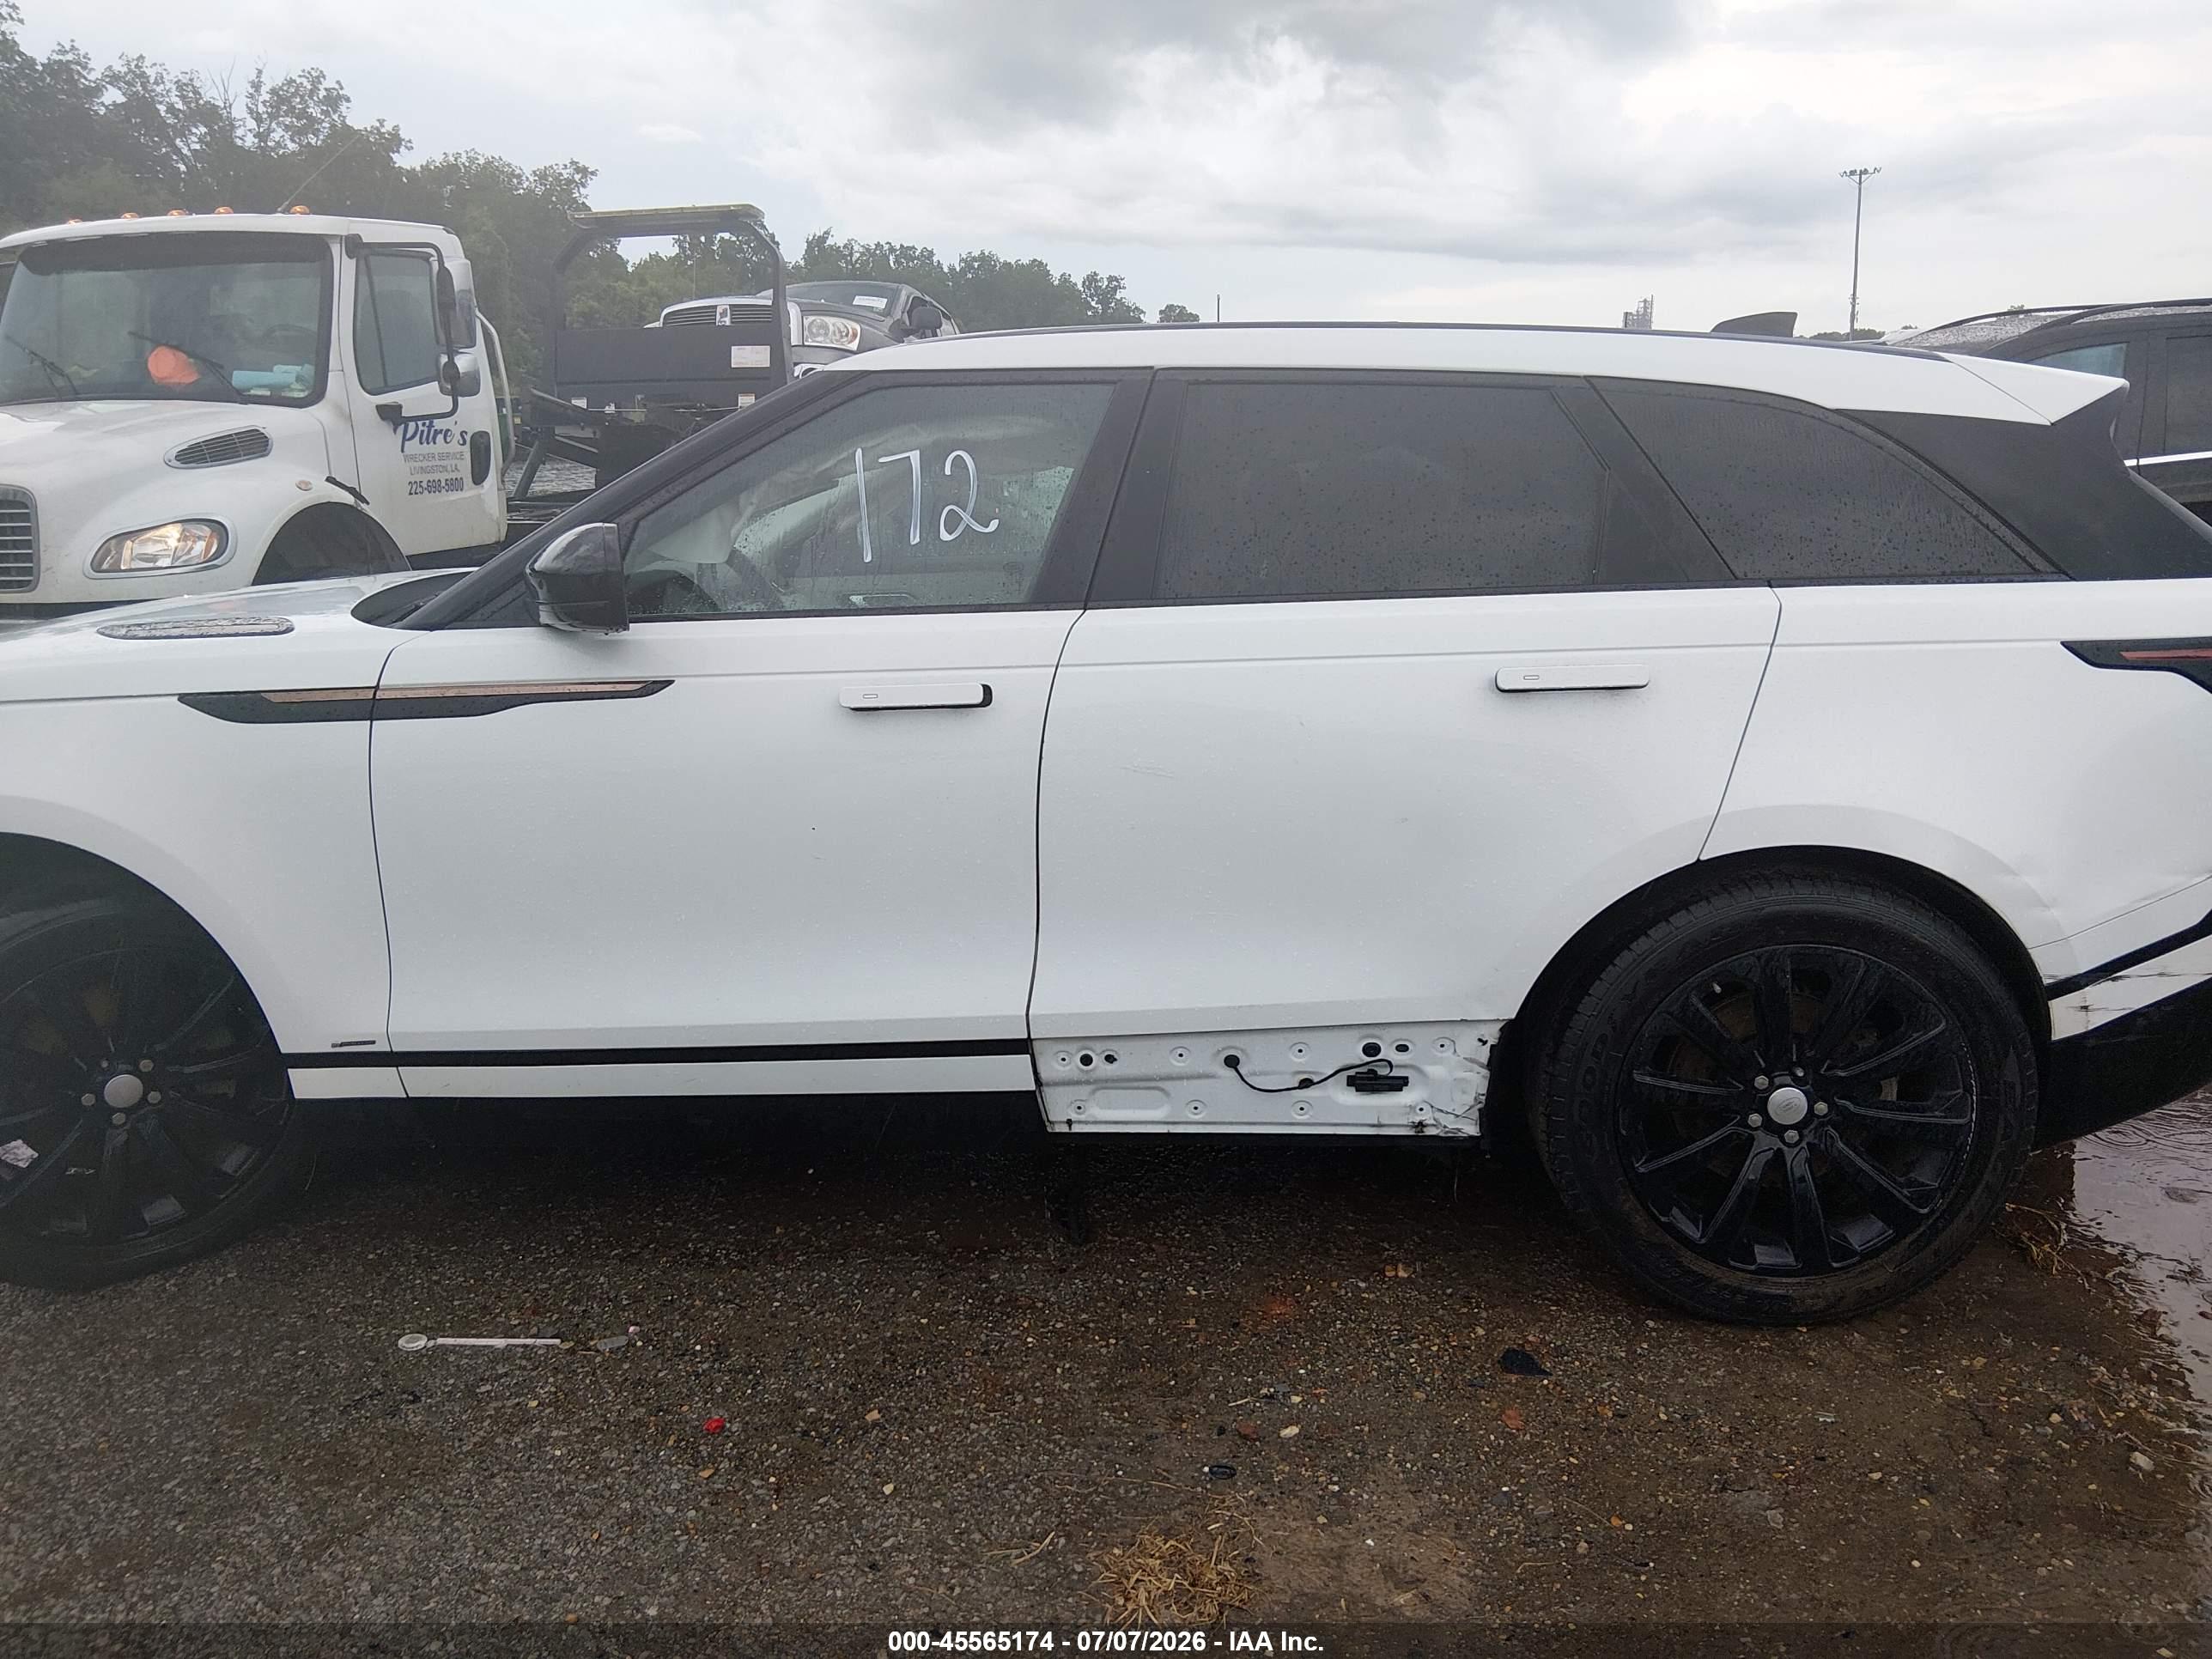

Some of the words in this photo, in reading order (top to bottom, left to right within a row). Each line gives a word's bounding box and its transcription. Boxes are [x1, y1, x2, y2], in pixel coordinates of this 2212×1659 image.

[400, 419, 468, 453] Pitre's
[403, 453, 436, 463] WRECKER
[437, 451, 465, 461] SERVICE
[408, 477, 464, 495] 225-698-5800
[855, 447, 1000, 563] 172
